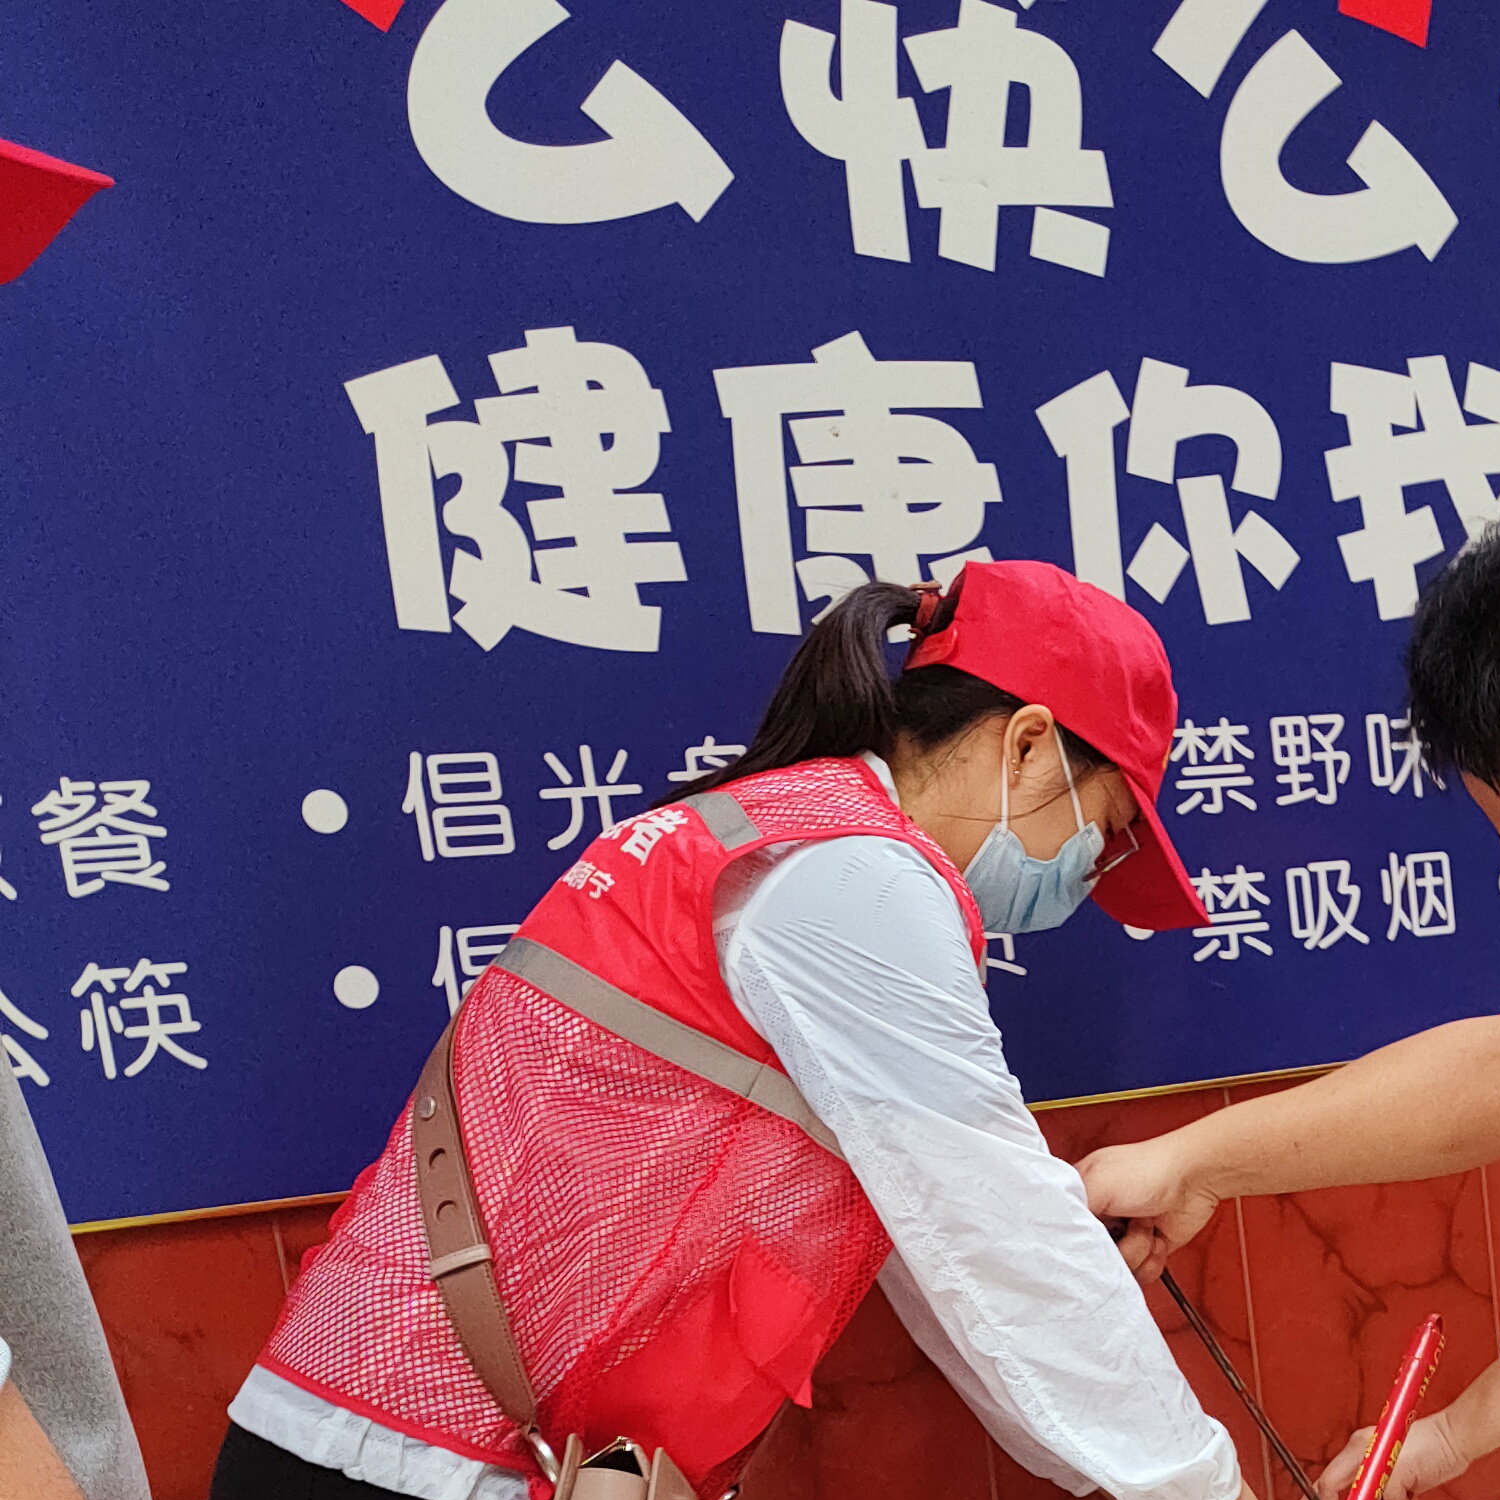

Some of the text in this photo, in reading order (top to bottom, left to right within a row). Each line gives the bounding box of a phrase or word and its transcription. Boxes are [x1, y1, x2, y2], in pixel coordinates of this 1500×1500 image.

[0, 776, 171, 900] 餐
[1189, 850, 1458, 963] 禁吸烟
